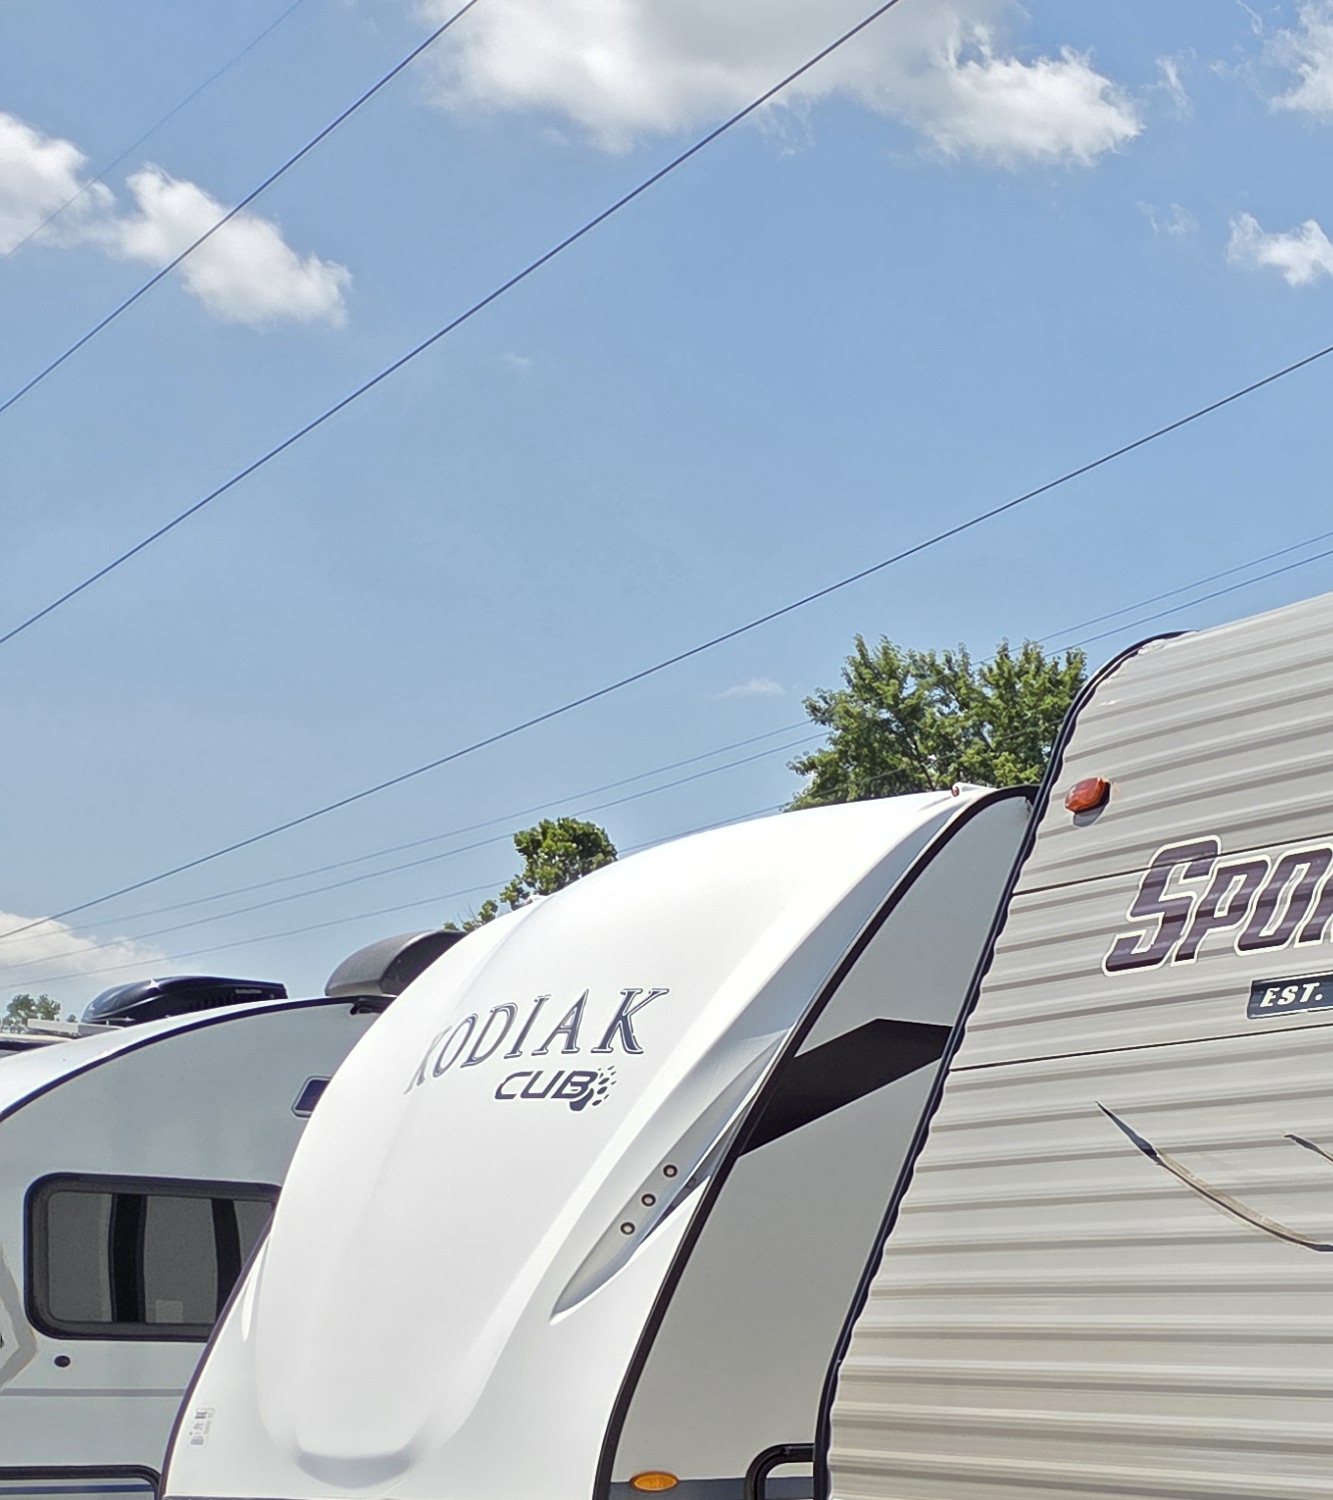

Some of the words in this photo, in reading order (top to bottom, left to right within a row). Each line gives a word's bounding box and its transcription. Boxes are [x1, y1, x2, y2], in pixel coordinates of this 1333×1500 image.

[1259, 982, 1324, 1009] EST.
[403, 987, 670, 1096] KODIAK
[494, 1070, 600, 1101] CUB
